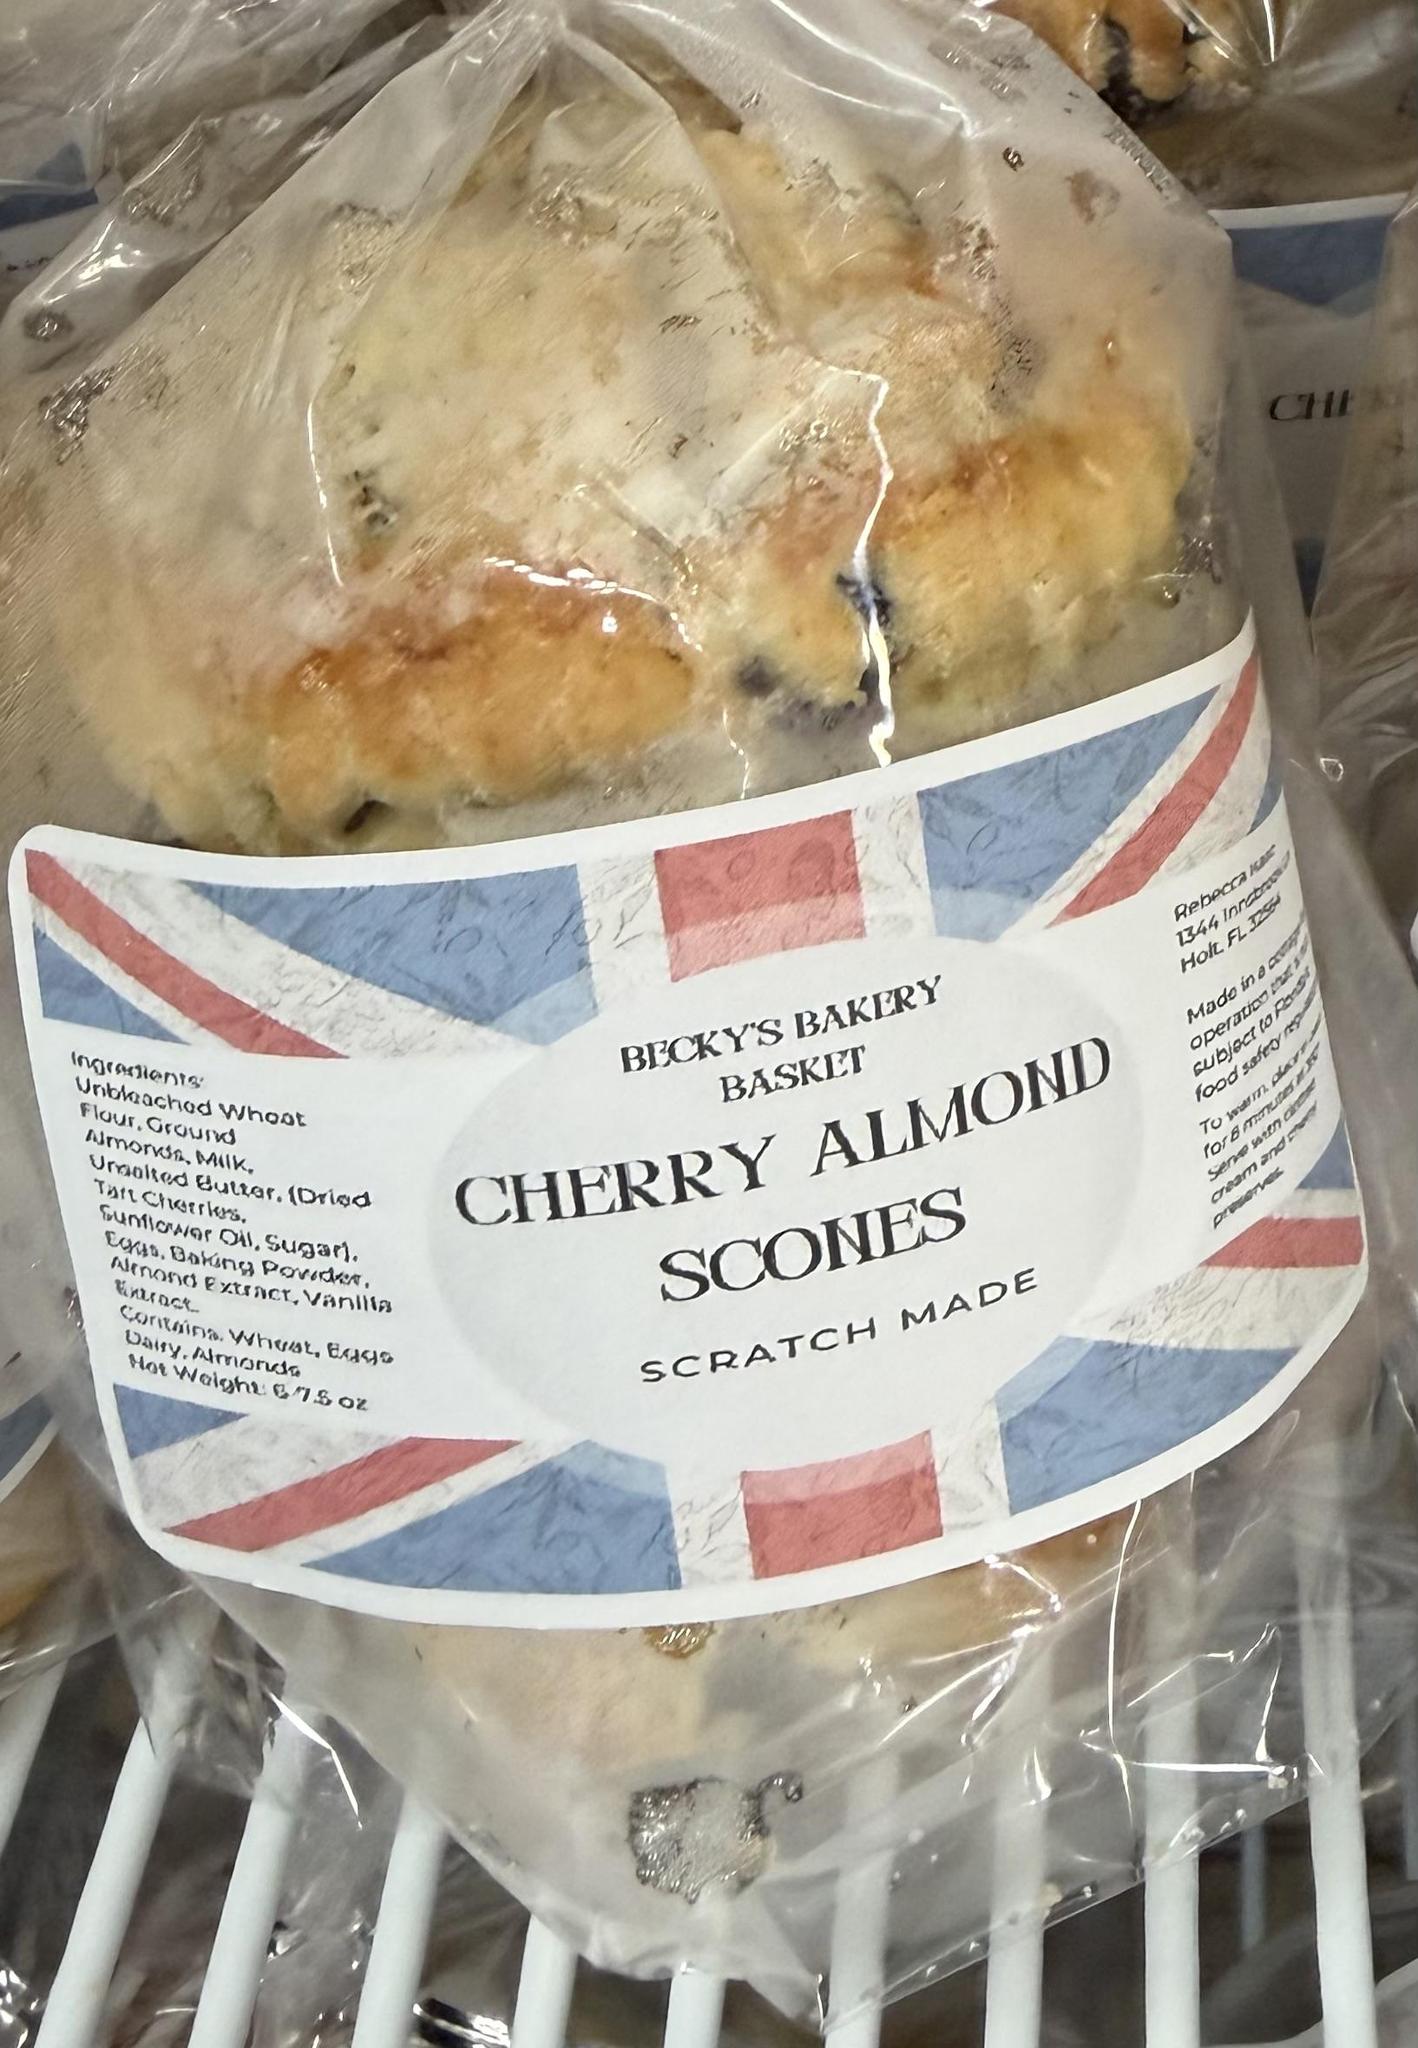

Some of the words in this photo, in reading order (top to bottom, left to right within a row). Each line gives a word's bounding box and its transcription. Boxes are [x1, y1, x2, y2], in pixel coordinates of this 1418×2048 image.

[1174, 871, 1248, 922] Rebecca
[1176, 914, 1219, 947] 1344
[1227, 926, 1248, 948] FL
[1187, 987, 1237, 1024] Made
[1240, 974, 1255, 993] in
[1258, 965, 1266, 980] a
[1190, 989, 1269, 1050] operation
[620, 1017, 783, 1073] BECKY'S
[794, 975, 943, 1039] BAKERY
[1193, 1026, 1257, 1077] subject
[1259, 1013, 1273, 1033] to
[719, 1045, 867, 1103] BASKET
[1195, 1065, 1238, 1102] food
[1242, 1033, 1281, 1076] safety
[75, 1076, 213, 1117] Unbleached
[218, 1102, 307, 1128] Wheat
[146, 1116, 236, 1145] Ground
[1199, 1117, 1222, 1134] To
[455, 1133, 776, 1227] CHERRY
[808, 1035, 1112, 1177] ALMOND
[1203, 1135, 1229, 1159] for
[1208, 1143, 1249, 1182] Serve
[1251, 1118, 1282, 1149] with
[89, 1154, 189, 1187] Unsalted
[288, 1185, 372, 1208] (Dried
[94, 1178, 138, 1203] Tart
[1211, 1162, 1258, 1204] cream
[1260, 1136, 1286, 1166] and
[100, 1204, 213, 1242] Sunflower
[659, 1186, 967, 1303] SCONES
[111, 1256, 197, 1288] Almond
[303, 1289, 392, 1313] Vanilla
[170, 1245, 255, 1277] Baking
[639, 1317, 877, 1383] SCRATCH
[900, 1267, 1039, 1331] MADE
[128, 1353, 167, 1376] Net
[338, 1396, 368, 1411] oz
[192, 1346, 301, 1377] Almonds
